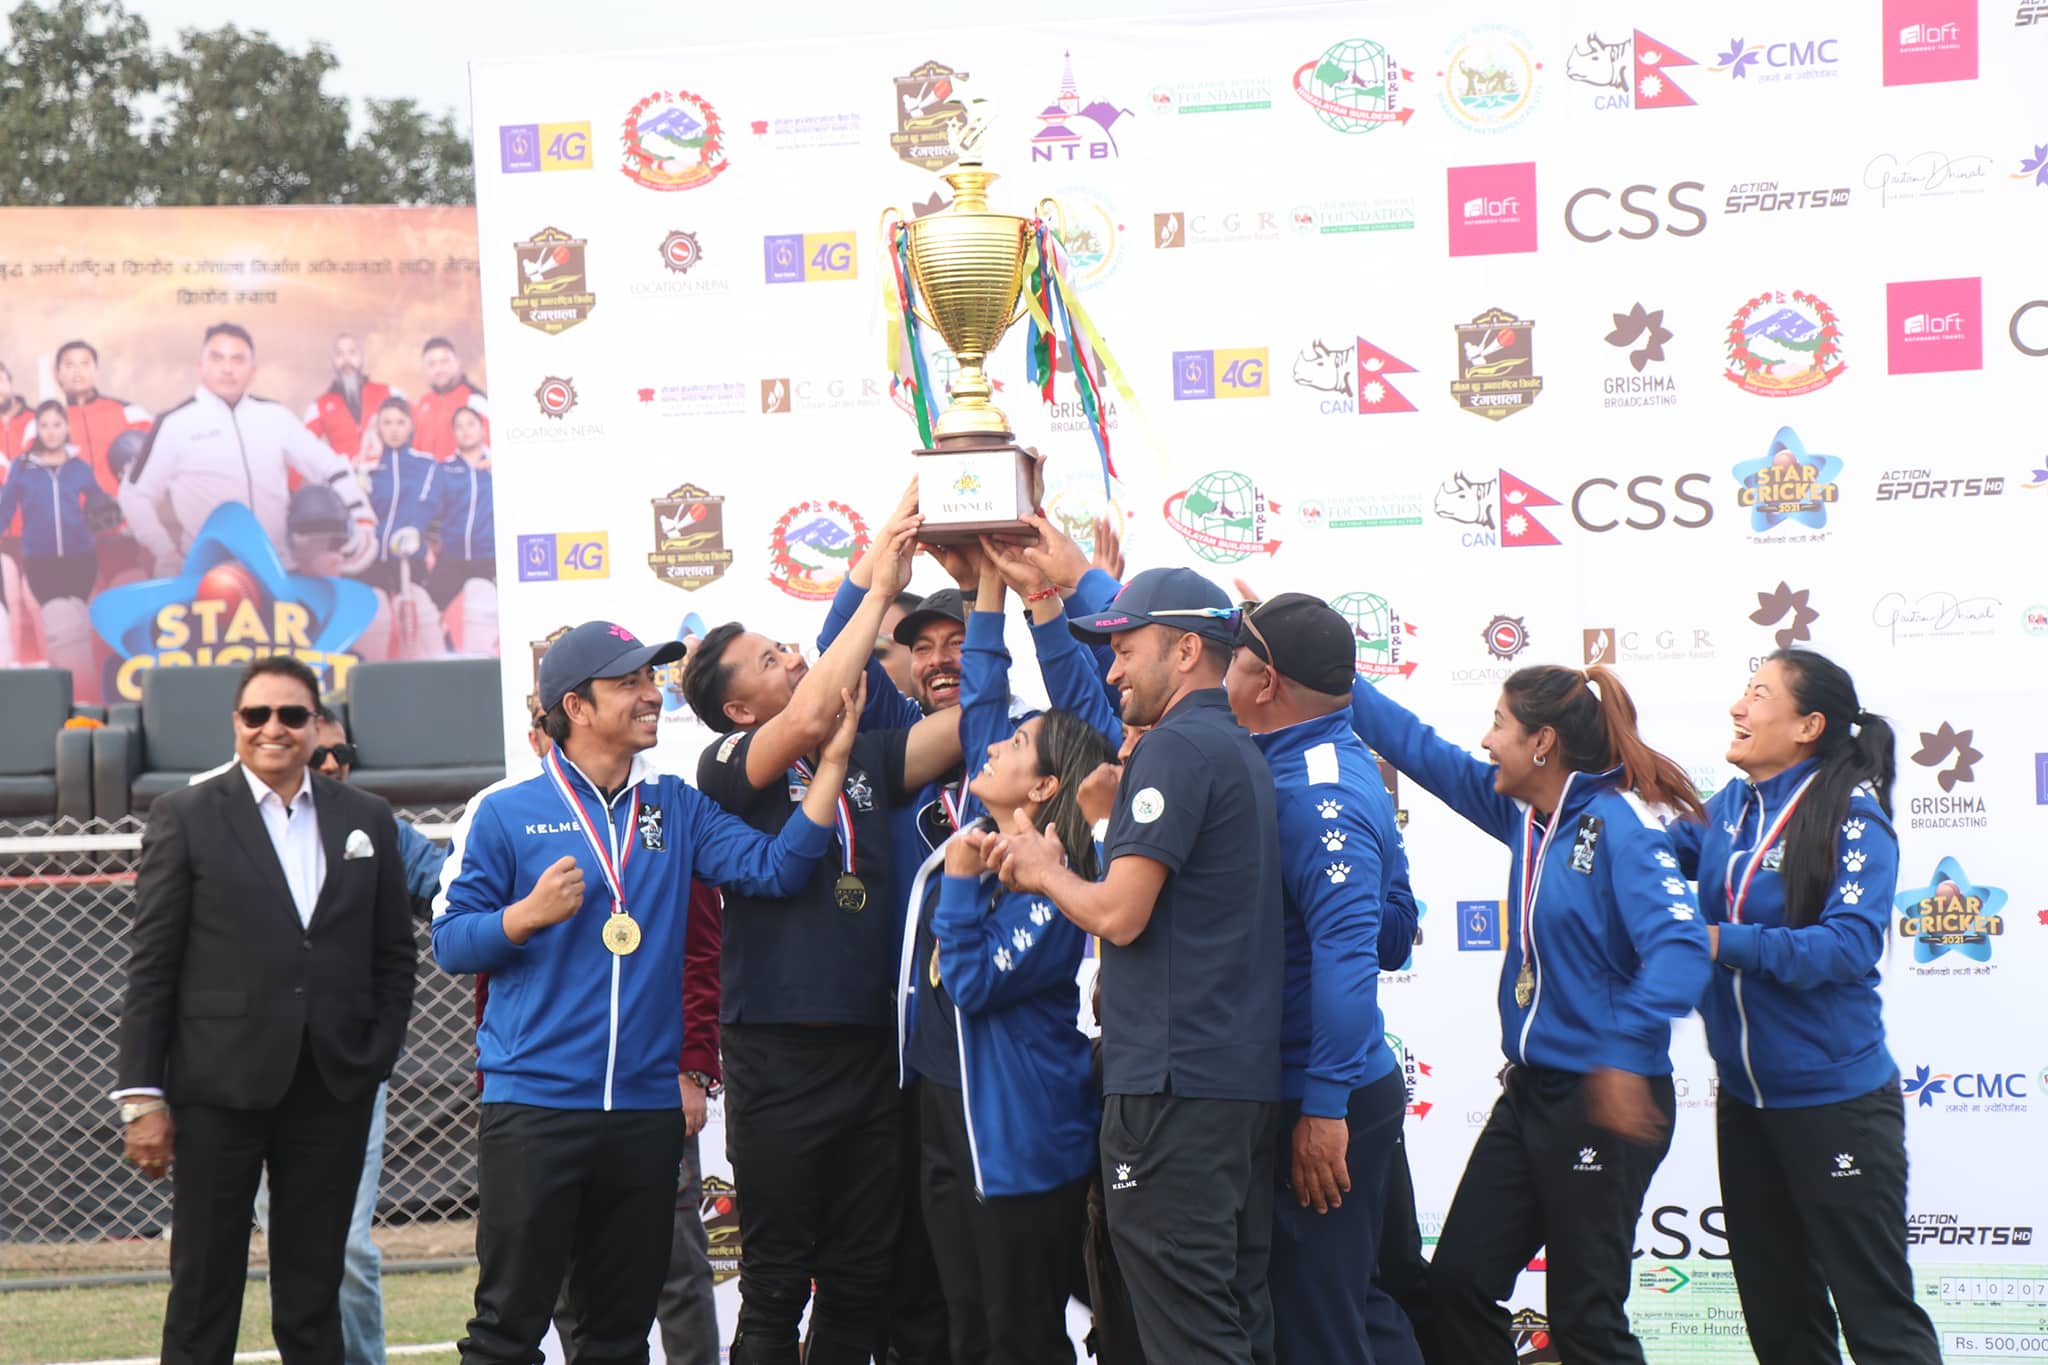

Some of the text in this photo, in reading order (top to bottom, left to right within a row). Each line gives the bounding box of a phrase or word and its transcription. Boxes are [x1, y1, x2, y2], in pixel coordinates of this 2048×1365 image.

[1900, 22, 1960, 45] aloft
[1766, 39, 1839, 67] CMC
[1594, 94, 1630, 110] CAN
[547, 131, 586, 161] 4G
[1032, 142, 1109, 163] NTB
[1730, 181, 1779, 193] ACTION
[1464, 196, 1521, 218] aloft
[1724, 189, 1850, 214] SPORTS HD
[1564, 180, 1708, 243] CSS
[811, 241, 852, 272] 4G
[629, 279, 693, 296] LOCATION
[1904, 312, 1965, 334] aloft
[1221, 357, 1264, 389] 4G
[1604, 375, 1676, 394] GRISHMA
[1050, 400, 1118, 418] GRISA
[1320, 400, 1354, 415] CAN
[1604, 394, 1677, 408] BROADCASTING
[506, 425, 568, 441] LOCATION
[1758, 464, 1817, 484] STAR
[1880, 468, 1931, 480] ACTION
[1743, 483, 1836, 505] CRICKET
[1876, 478, 2004, 501] SPORTS HD
[943, 501, 993, 513] WINNER
[1571, 472, 1714, 533] CSS
[1462, 532, 1496, 547] CAN
[563, 541, 604, 571] 4G
[156, 598, 312, 649] STAR
[1096, 617, 1129, 627] KELME
[1911, 796, 1986, 815] GRISHMA
[525, 821, 581, 835] KELME
[1911, 816, 1987, 829] BROADCASTING
[1920, 896, 1980, 915] STAR
[1905, 914, 2000, 935] CRICKET
[1942, 936, 1964, 944] 2021
[1953, 1073, 2027, 1098] CMC
[1112, 1180, 1138, 1190] KELME
[1908, 1214, 1958, 1224] ACTION
[1630, 1204, 1730, 1261] SS
[1906, 1226, 2032, 1246] SPORTS HD
[1671, 1322, 1698, 1334] Five
[1704, 1322, 1747, 1335] Hundr
[1956, 1336, 2048, 1353] Rs. 500,000
